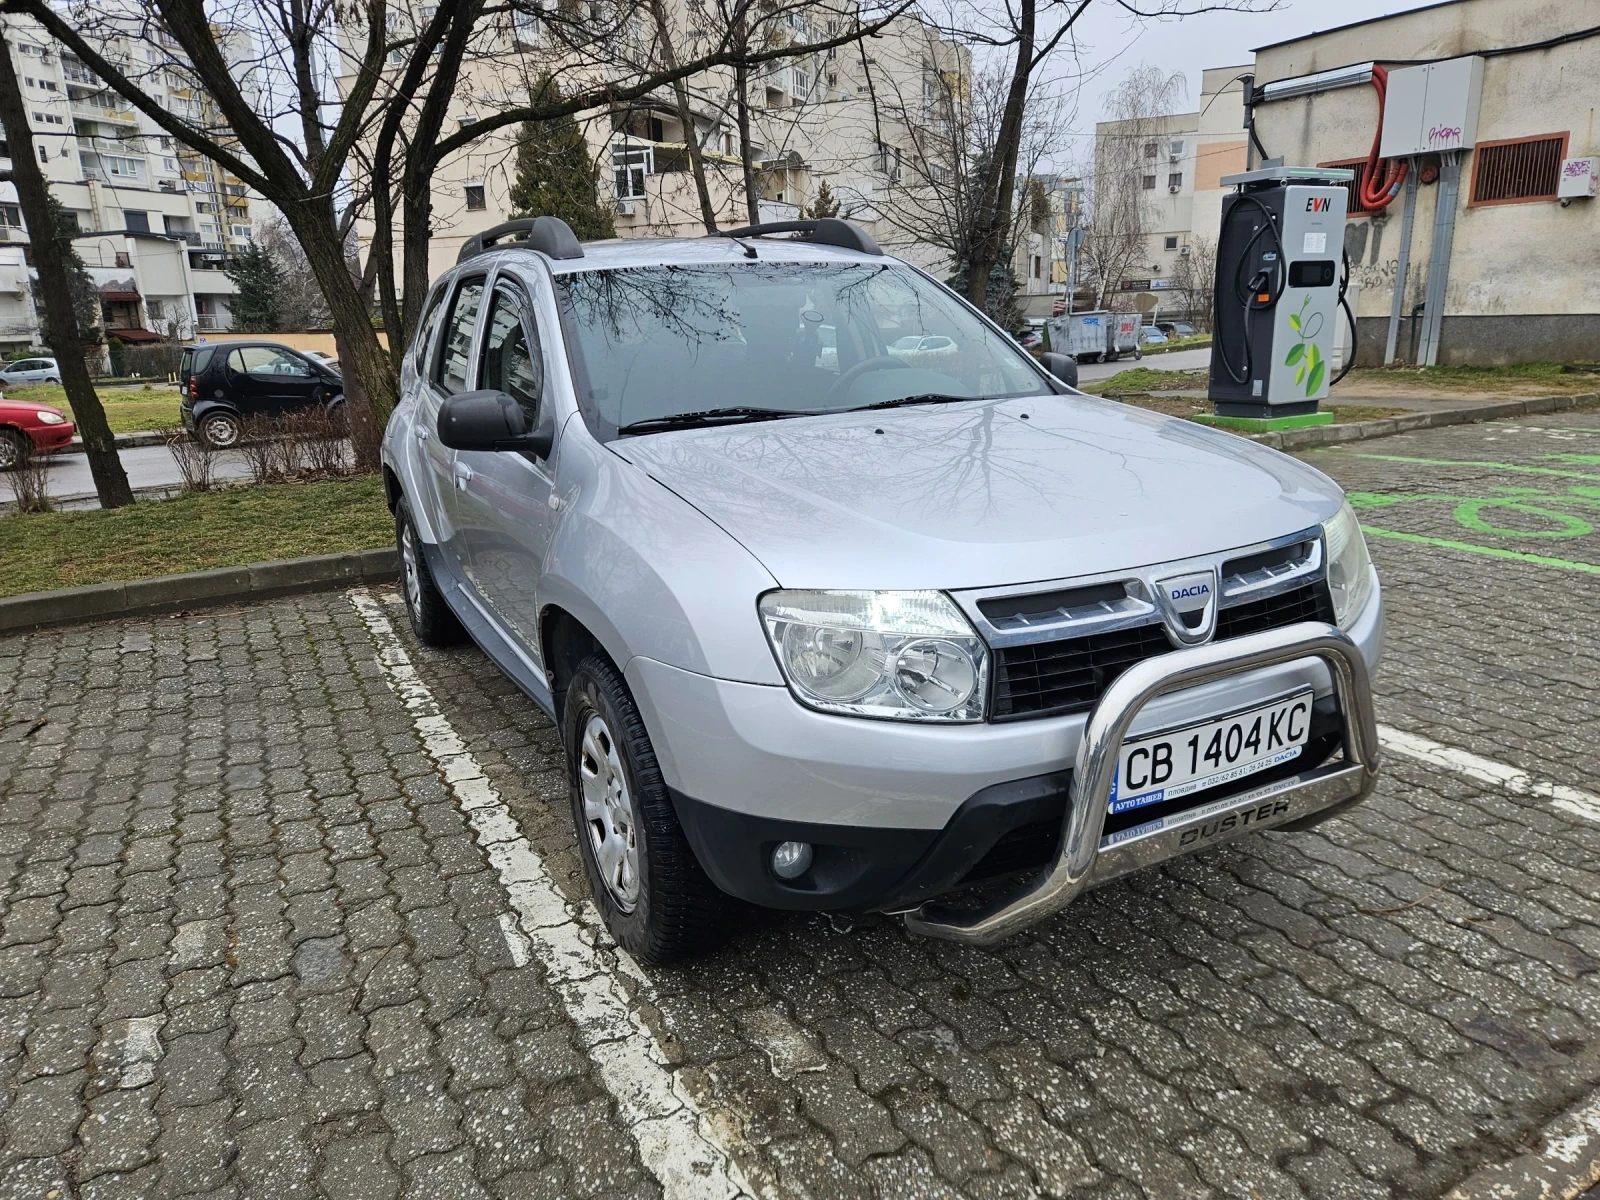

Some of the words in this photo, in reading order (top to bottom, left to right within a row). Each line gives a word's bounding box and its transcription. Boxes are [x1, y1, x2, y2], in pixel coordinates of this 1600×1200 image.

[1305, 197, 1331, 212] EVN
[1171, 584, 1210, 600] DACIA
[1115, 799, 1136, 811] АУТО
[1136, 792, 1162, 806] ТАШЕВ
[1274, 750, 1298, 763] DACIA
[1126, 742, 1173, 790] CB
[1179, 798, 1290, 847] DUSTER
